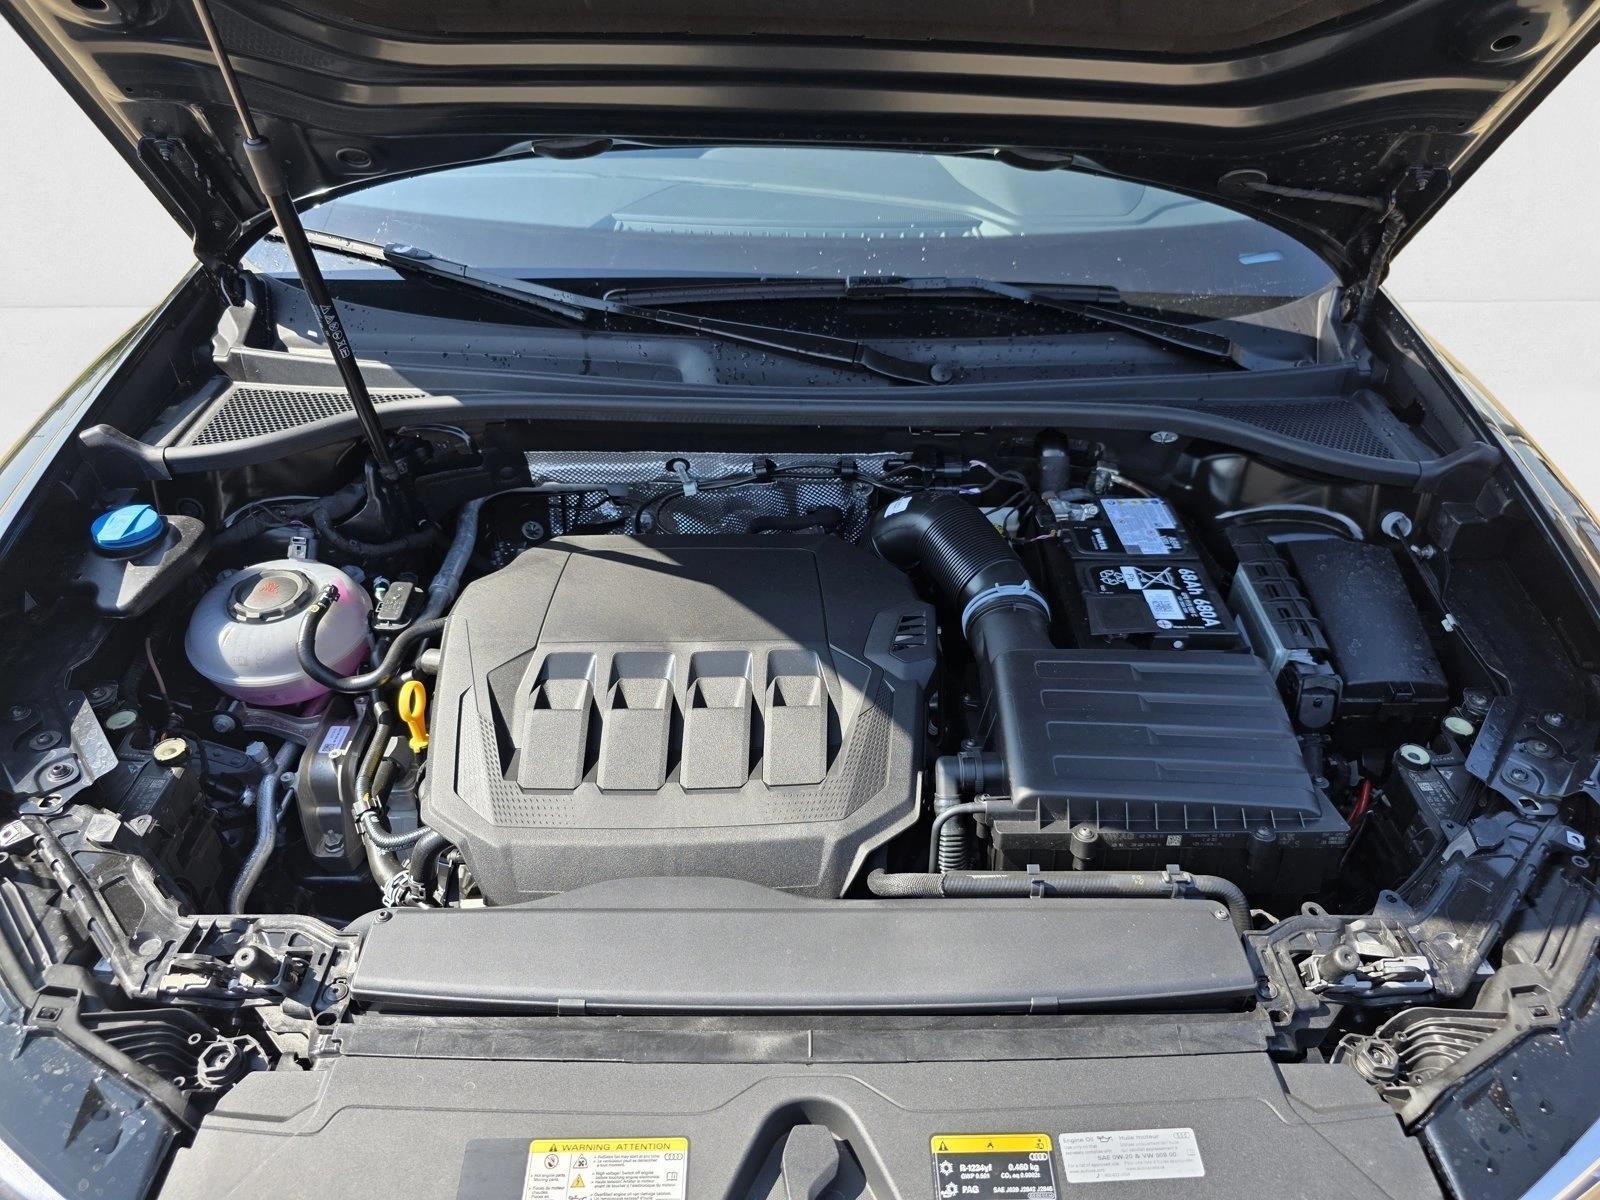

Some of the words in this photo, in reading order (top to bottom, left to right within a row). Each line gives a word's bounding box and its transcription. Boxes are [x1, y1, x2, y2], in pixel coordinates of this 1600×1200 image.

[1178, 568, 1204, 595] 68Ah
[1193, 598, 1221, 627] 680A
[562, 1144, 611, 1152] WARNING
[616, 1142, 671, 1151] ATTENTION
[1029, 1163, 1040, 1172] kg
[962, 1185, 980, 1194] PAG
